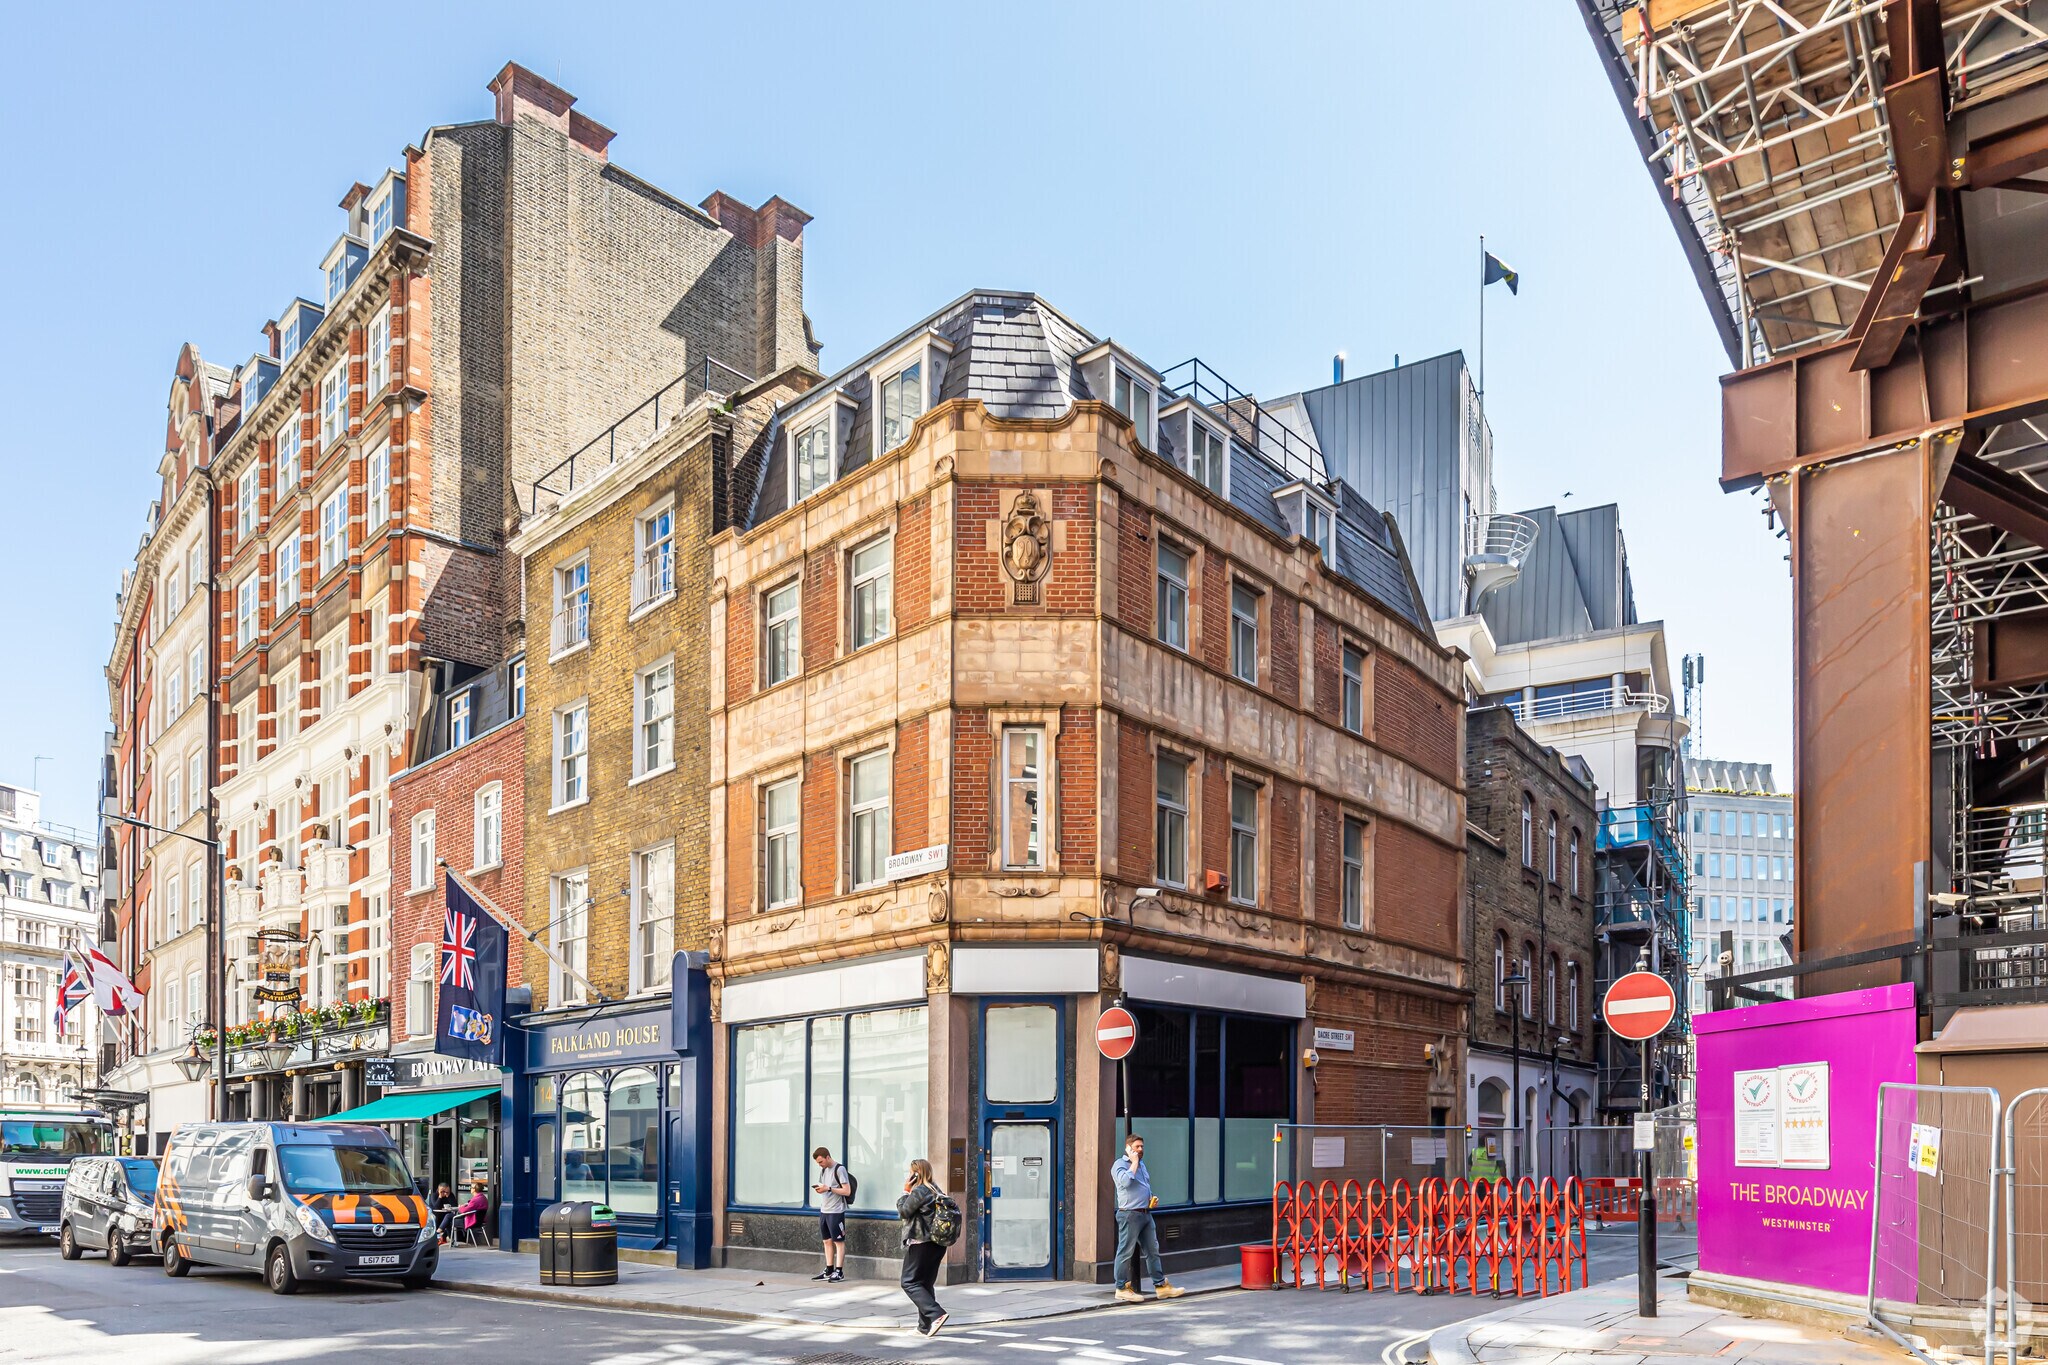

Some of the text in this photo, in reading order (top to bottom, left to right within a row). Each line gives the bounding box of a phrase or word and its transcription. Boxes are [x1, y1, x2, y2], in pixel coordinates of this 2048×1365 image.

[888, 848, 943, 869] BROADWAY SW1
[259, 991, 299, 1001] FEATHERS
[551, 1025, 660, 1054] FALKLAND HOUSE
[1317, 1030, 1353, 1041] DACRE STREET SW1
[366, 1063, 395, 1077] BROADWAY
[411, 1060, 465, 1078] BROADWAY
[540, 1086, 553, 1104] 14
[1729, 1182, 1869, 1210] THE BROADWAY
[1762, 1217, 1831, 1232] WESTMINSTER
[363, 1256, 380, 1264] LS17
